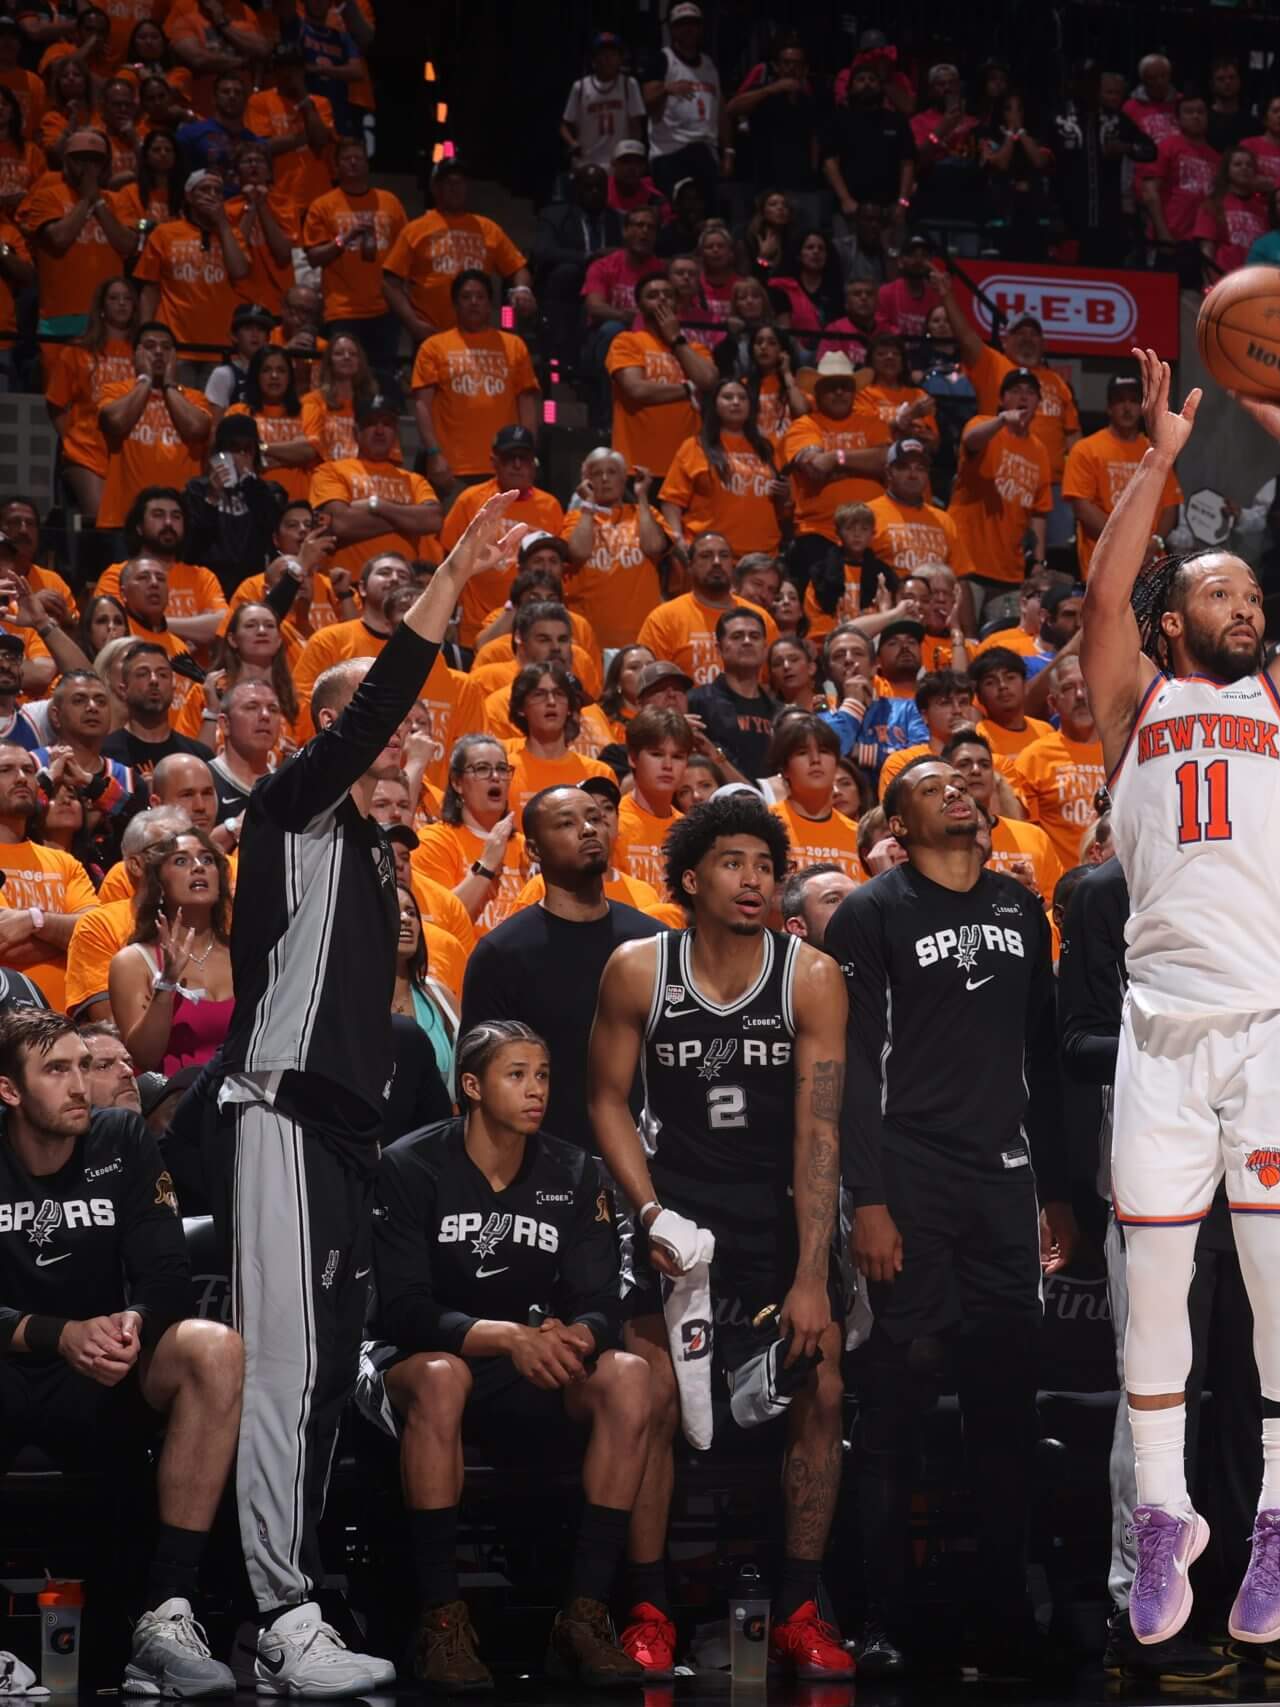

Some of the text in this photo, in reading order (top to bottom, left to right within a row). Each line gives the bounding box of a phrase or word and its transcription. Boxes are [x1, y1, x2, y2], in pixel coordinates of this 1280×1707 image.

[1137, 712, 1280, 767] NEW YORK
[1175, 759, 1233, 845] 11
[805, 845, 839, 858] 2026
[914, 923, 1025, 973] SPURS
[746, 1017, 778, 1027] LEDGER
[655, 1037, 792, 1081] SPURS
[705, 1084, 749, 1130] 2
[88, 1160, 121, 1180] LEDGER
[538, 1192, 571, 1203] LEDGER
[437, 1211, 560, 1259] SPURS
